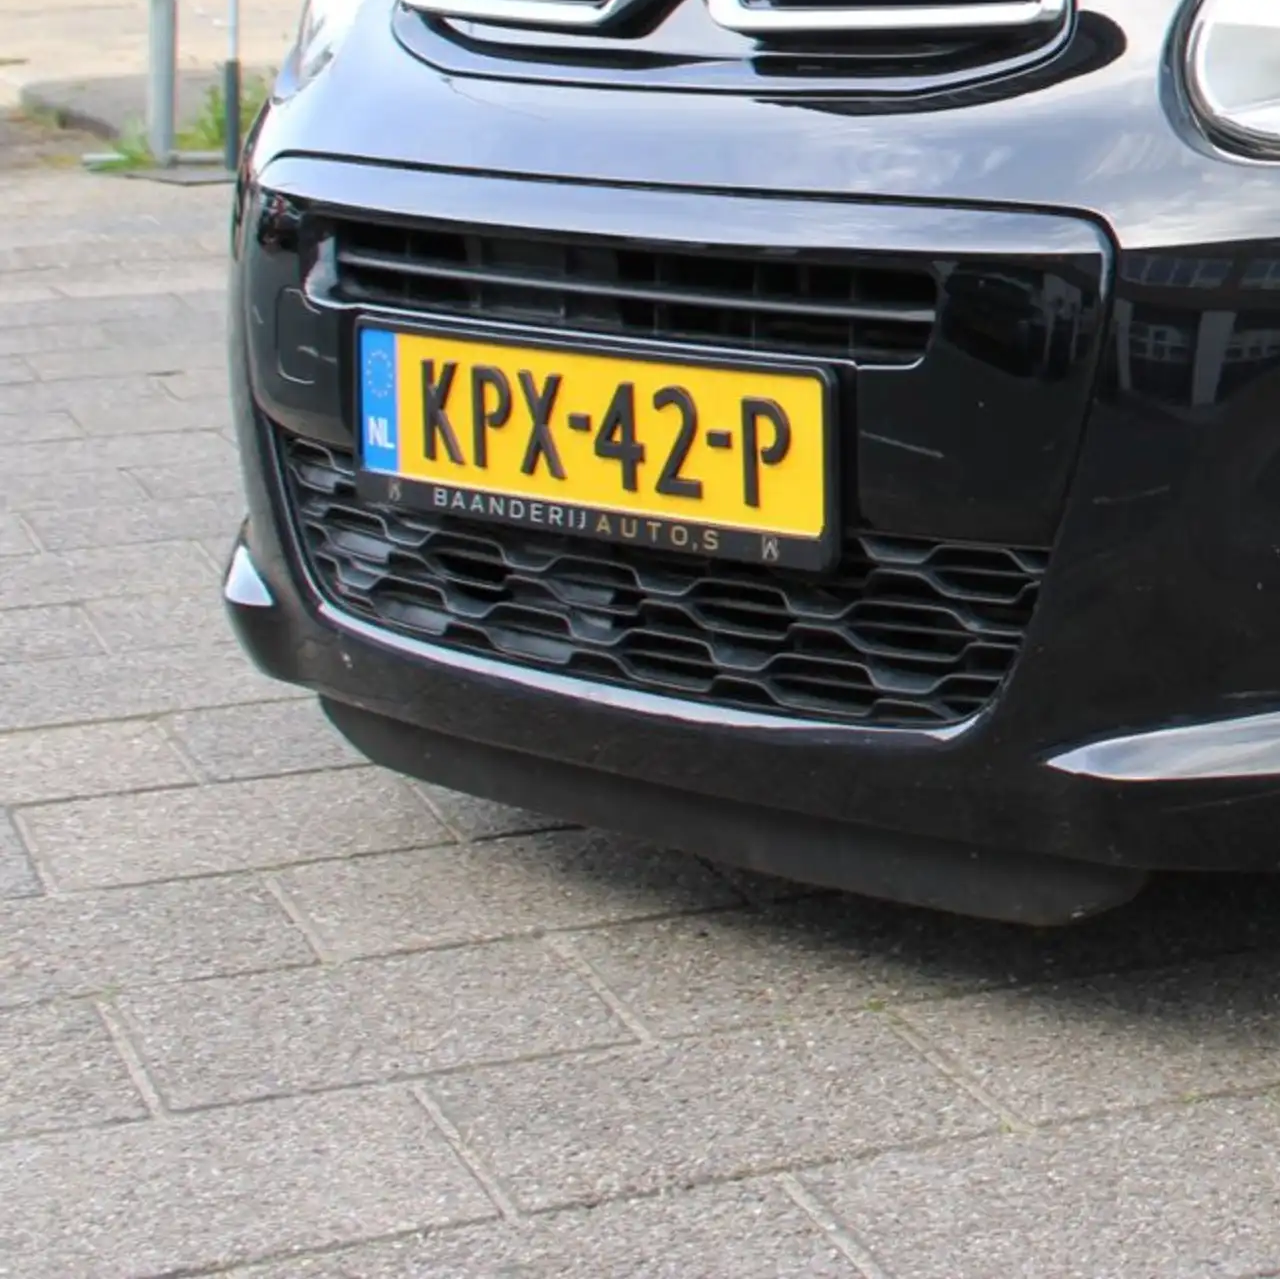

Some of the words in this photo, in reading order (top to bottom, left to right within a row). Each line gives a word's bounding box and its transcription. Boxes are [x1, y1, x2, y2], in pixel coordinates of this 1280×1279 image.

[368, 416, 395, 449] NL
[420, 358, 793, 508] KPX-42-P
[432, 486, 587, 531] BAANDERIJ
